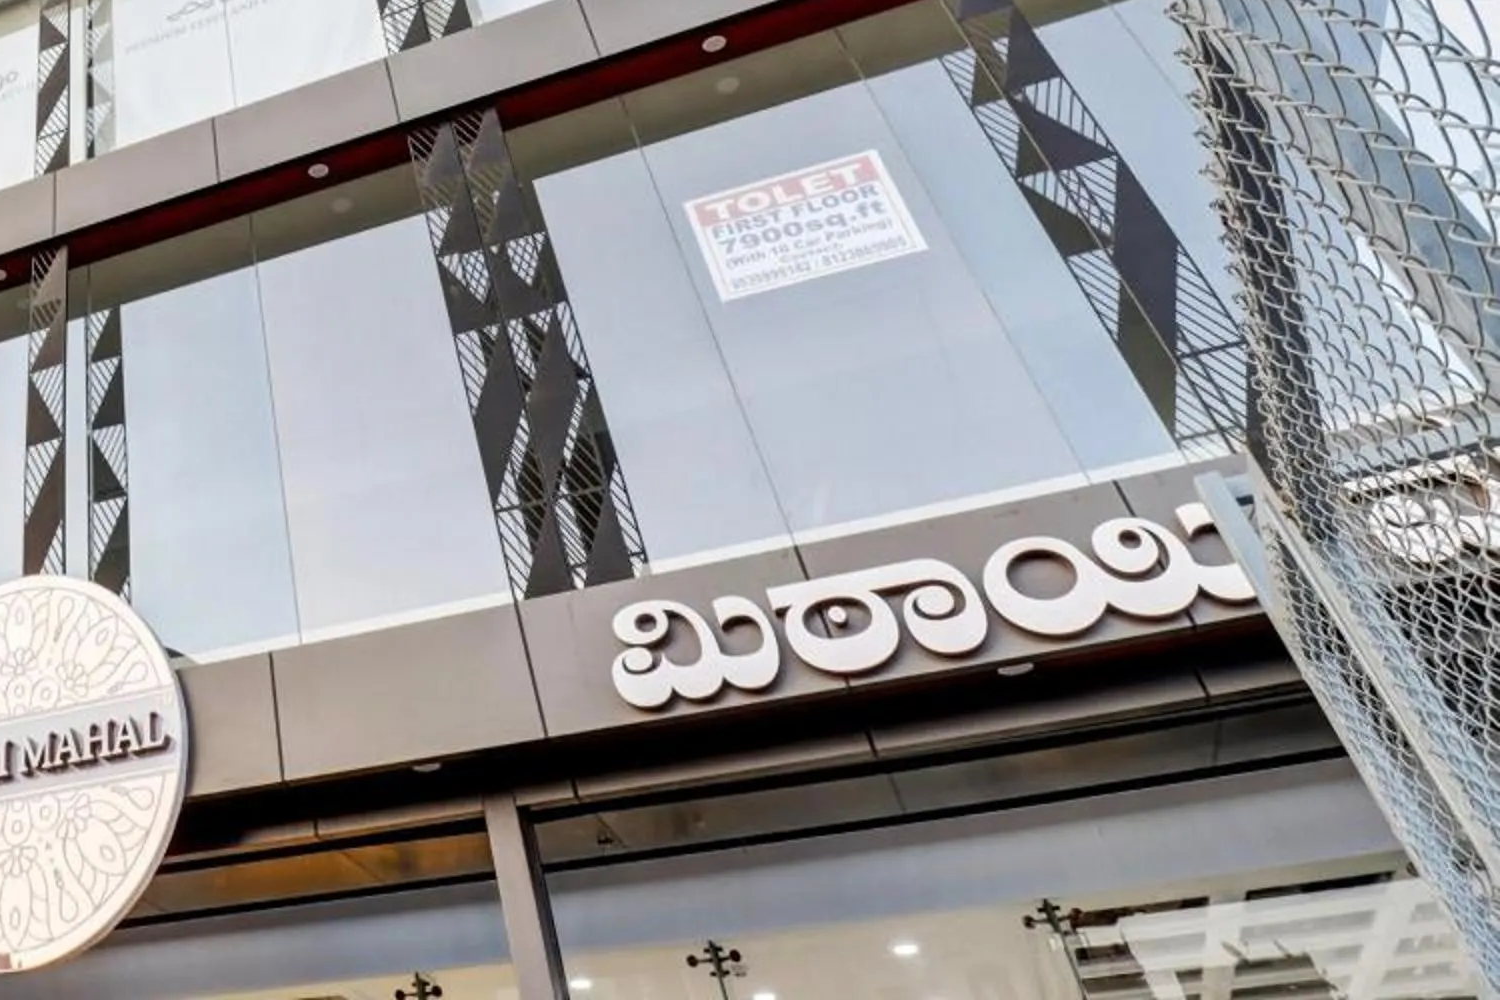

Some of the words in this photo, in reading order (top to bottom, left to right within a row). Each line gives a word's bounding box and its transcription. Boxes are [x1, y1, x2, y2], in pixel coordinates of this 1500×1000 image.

[704, 164, 861, 220] TOLET
[713, 212, 782, 237] FIRST
[793, 184, 879, 215] FLOOR
[721, 200, 886, 254] 7900sq.ft
[20, 708, 174, 778] MAHAL
